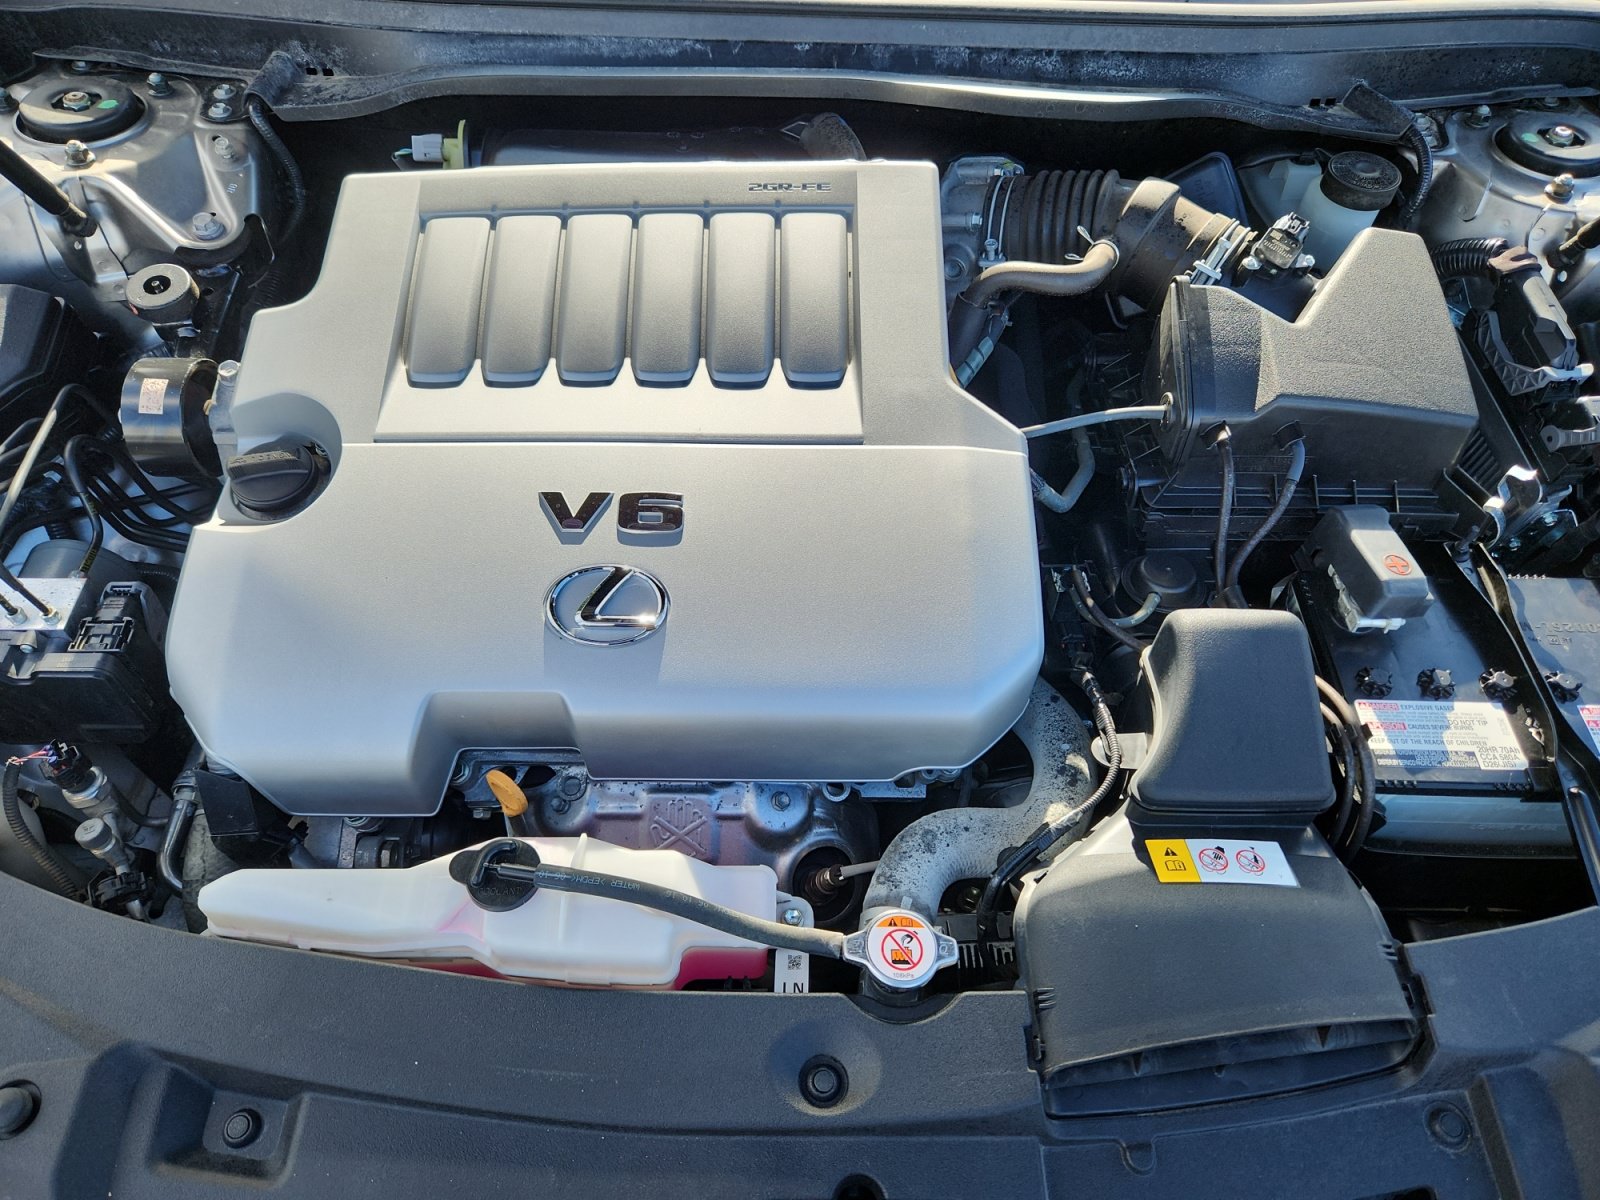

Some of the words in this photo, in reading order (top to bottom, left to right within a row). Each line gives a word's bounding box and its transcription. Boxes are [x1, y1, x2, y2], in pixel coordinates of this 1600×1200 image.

[748, 183, 832, 193] 2GR-FE
[538, 491, 684, 534] V6
[1476, 745, 1498, 753] 20HR
[1498, 746, 1520, 754] 70Ah
[611, 879, 641, 891] WATER
